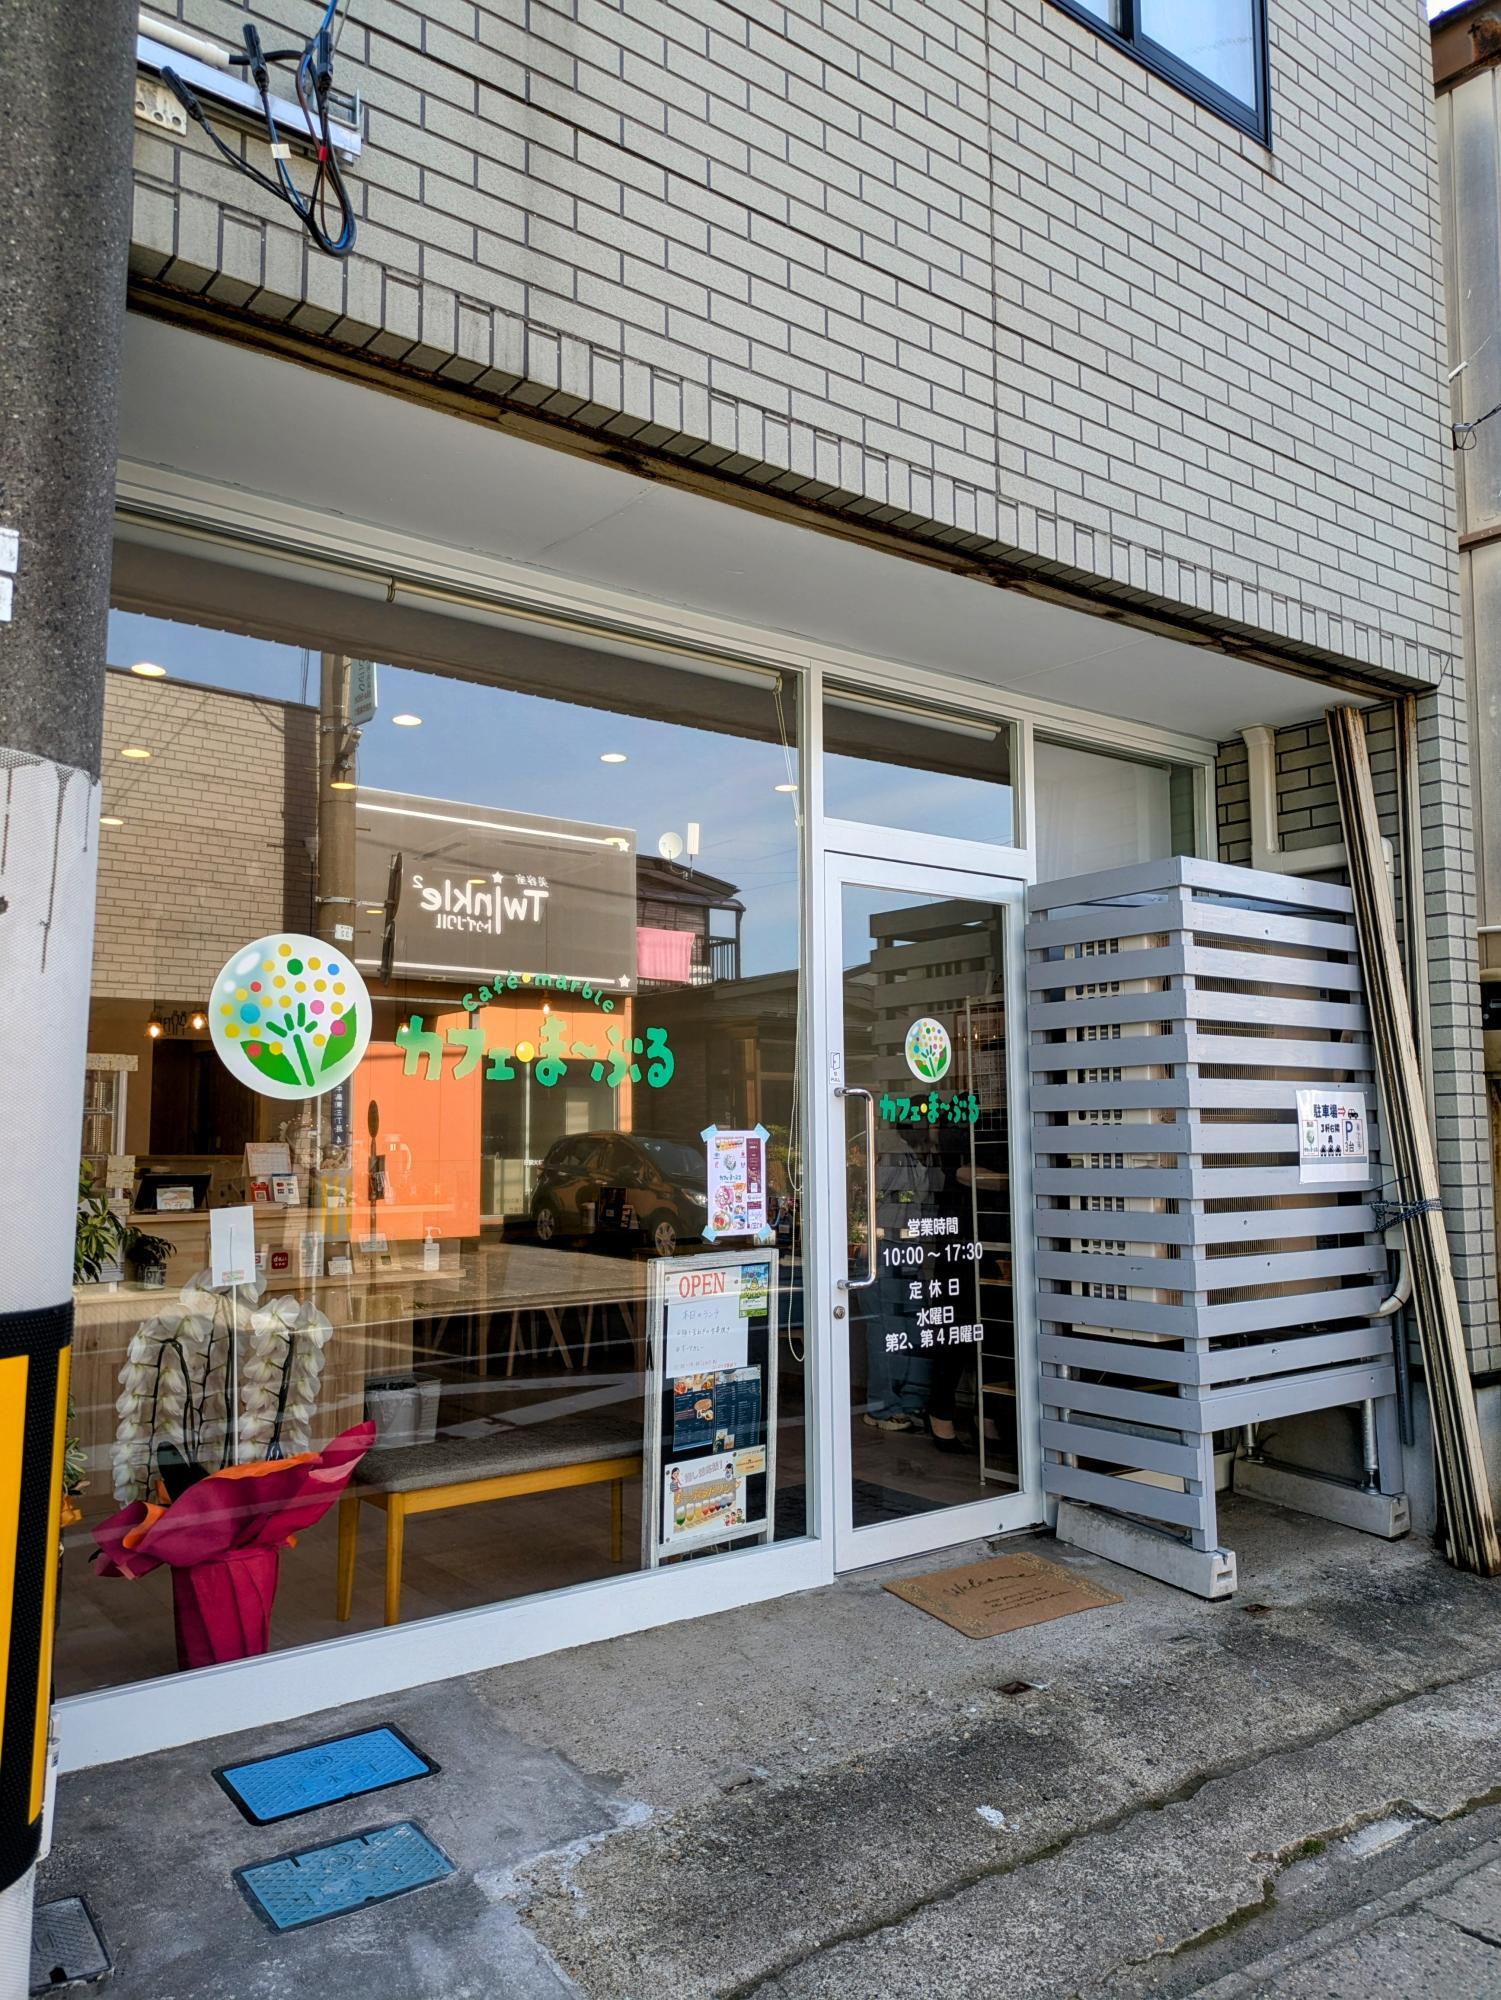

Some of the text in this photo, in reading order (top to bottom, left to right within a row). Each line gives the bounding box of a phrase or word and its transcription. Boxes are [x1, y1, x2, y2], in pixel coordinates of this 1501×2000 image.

[535, 973, 615, 1013] marble
[1313, 1104, 1338, 1118] 駐車場
[907, 1217, 959, 1238] 営業時間
[679, 1272, 727, 1298] OPEN
[916, 1306, 955, 1327] 水曜日
